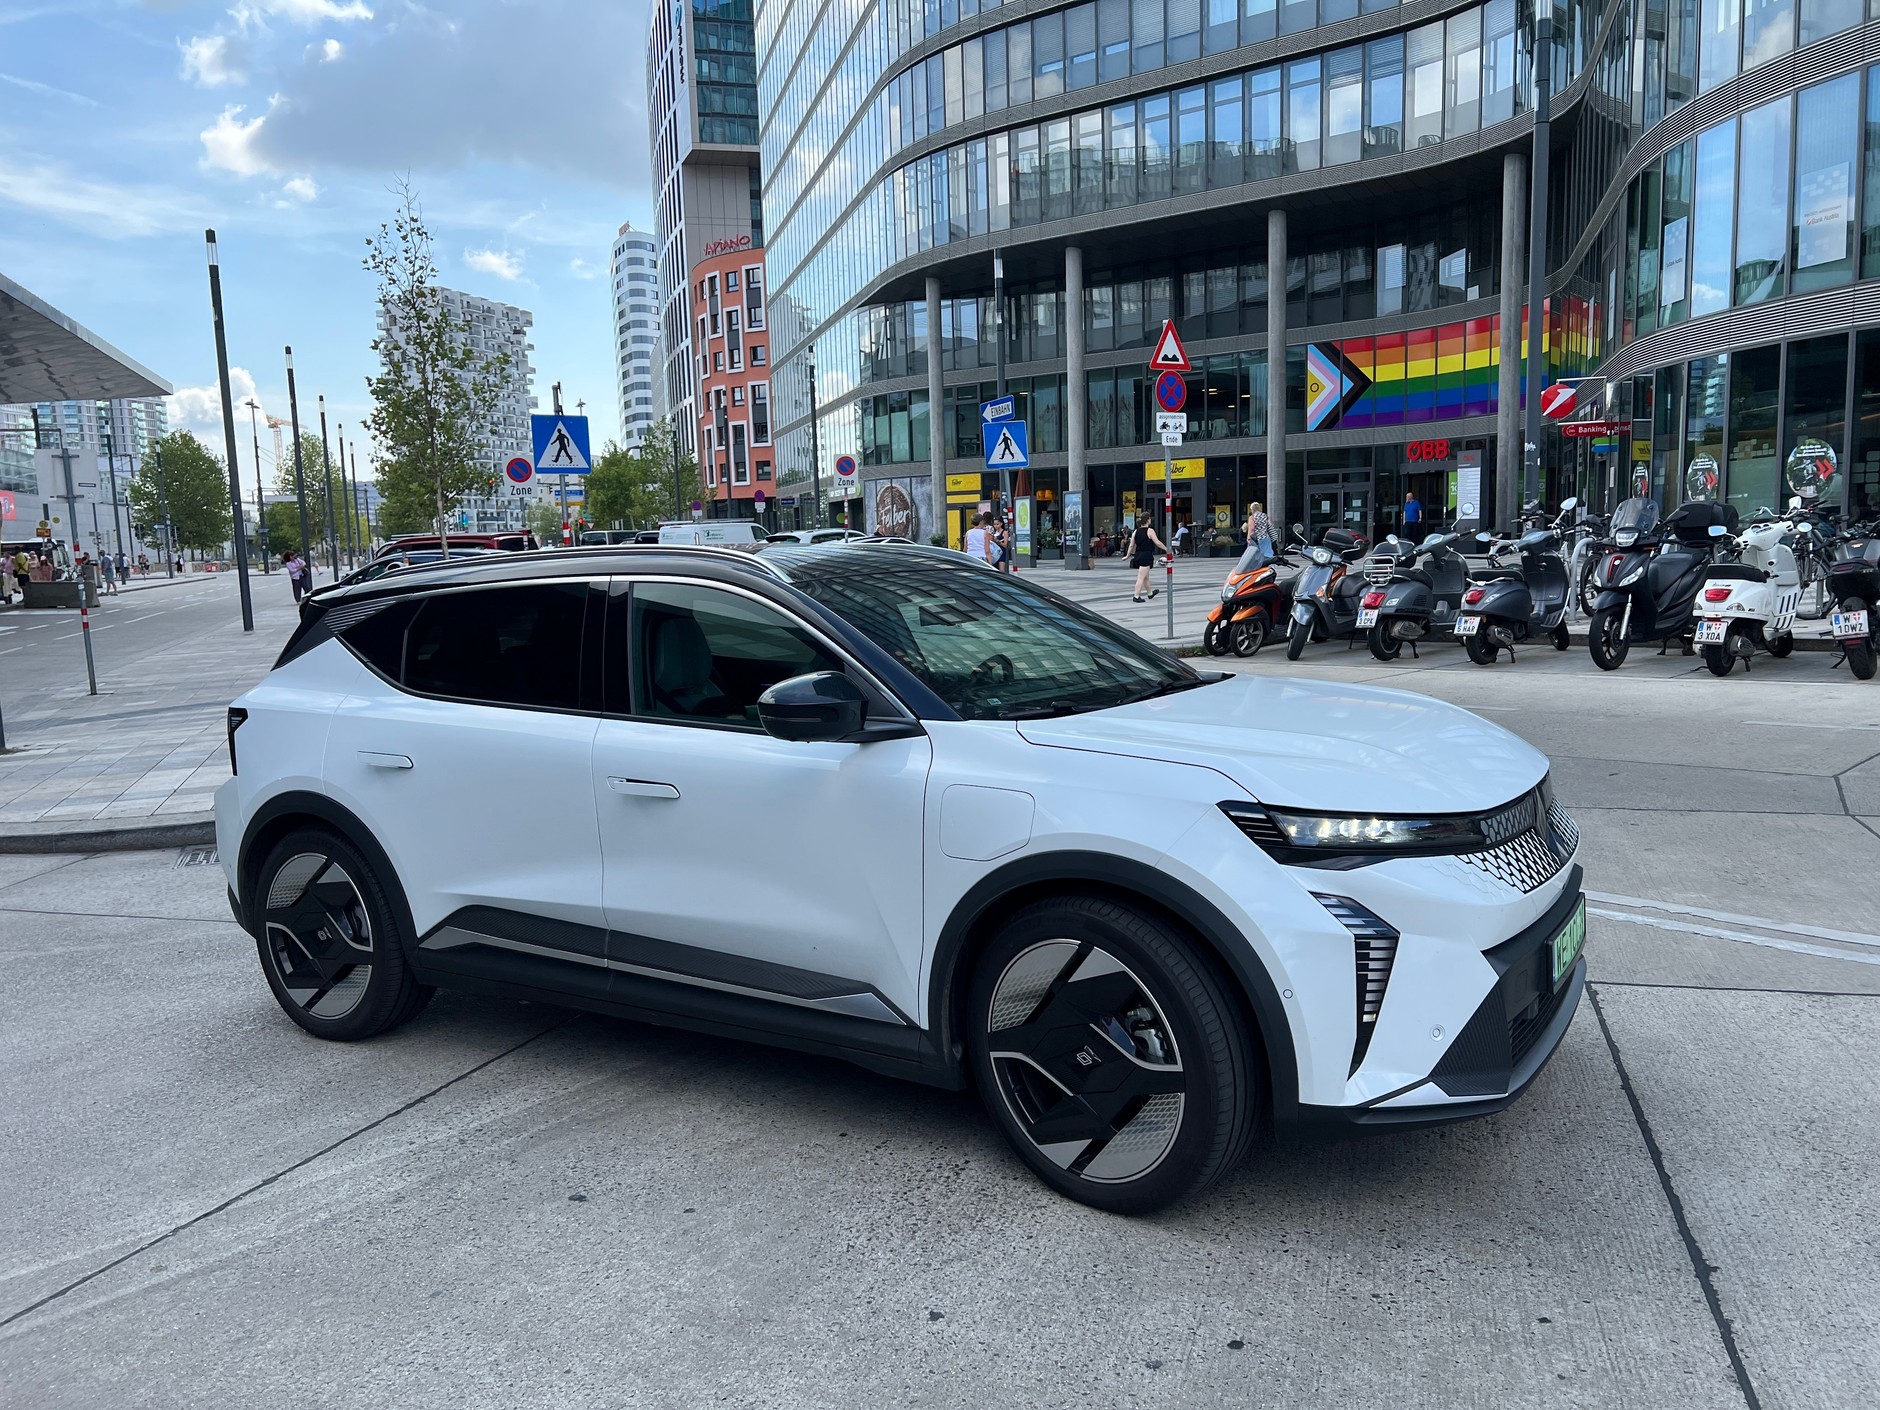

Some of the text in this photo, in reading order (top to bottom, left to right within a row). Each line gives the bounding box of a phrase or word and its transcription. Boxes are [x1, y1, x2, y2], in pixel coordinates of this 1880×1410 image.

[991, 402, 1011, 417] EINBAHN
[1578, 426, 1607, 434] Banking
[1166, 435, 1178, 443] Ende
[1406, 438, 1450, 461] ÖBB
[837, 477, 855, 486] Zone
[510, 485, 532, 496] Zone
[880, 504, 912, 528] Felber
[1843, 614, 1851, 624] W
[1706, 623, 1714, 631] W
[1698, 632, 1704, 640] 3
